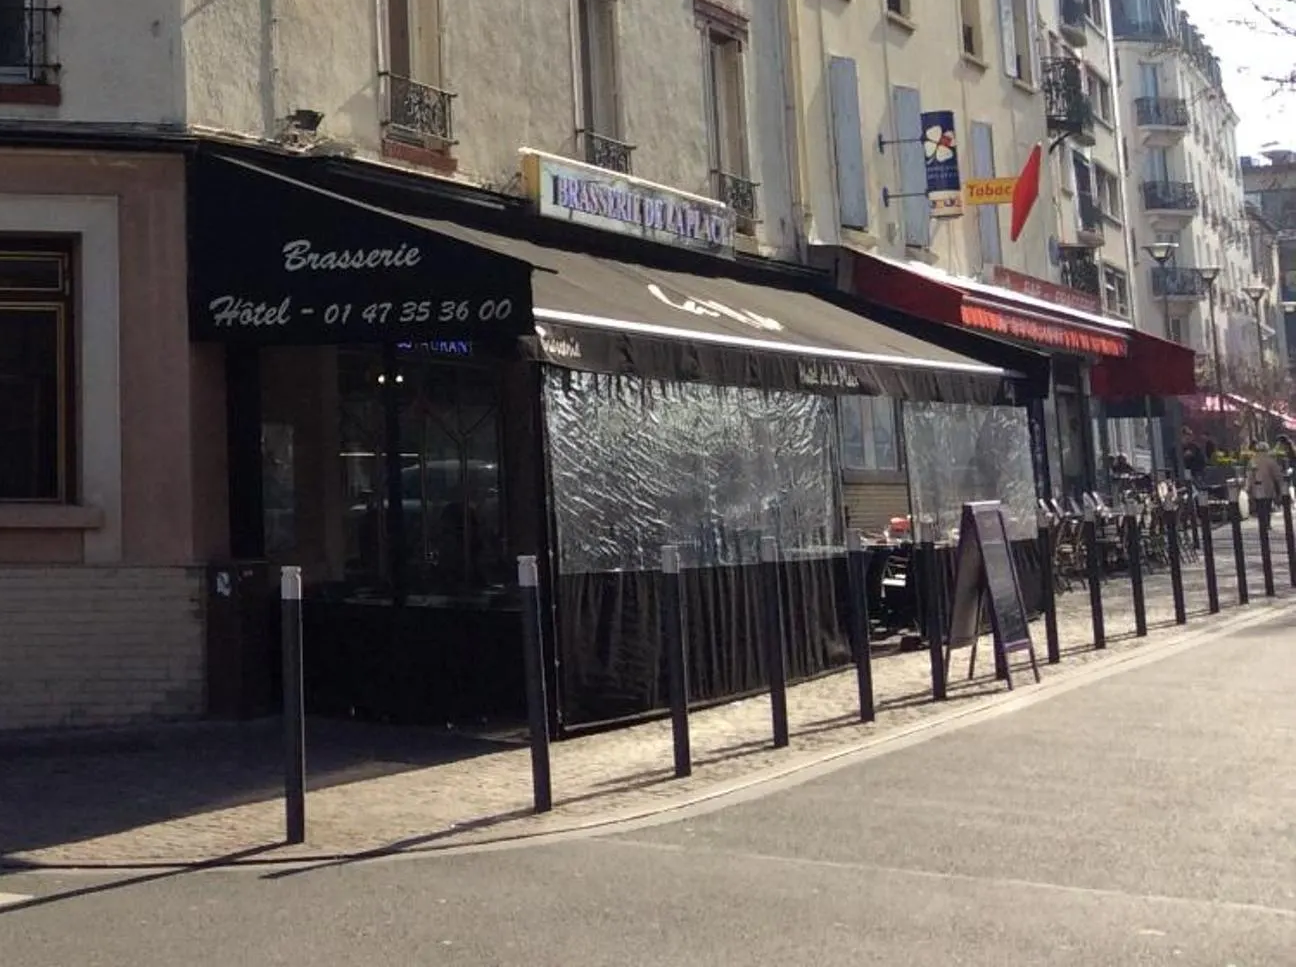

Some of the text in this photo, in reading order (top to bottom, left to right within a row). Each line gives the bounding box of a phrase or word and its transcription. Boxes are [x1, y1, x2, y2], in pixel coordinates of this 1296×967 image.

[967, 183, 1013, 197] Tabac
[283, 239, 422, 272] Brasserie
[208, 296, 292, 327] Hôtel
[324, 303, 352, 325] 01
[362, 302, 392, 325] 47
[400, 301, 431, 323] 35
[439, 300, 469, 322] 36
[479, 298, 512, 322] 00
